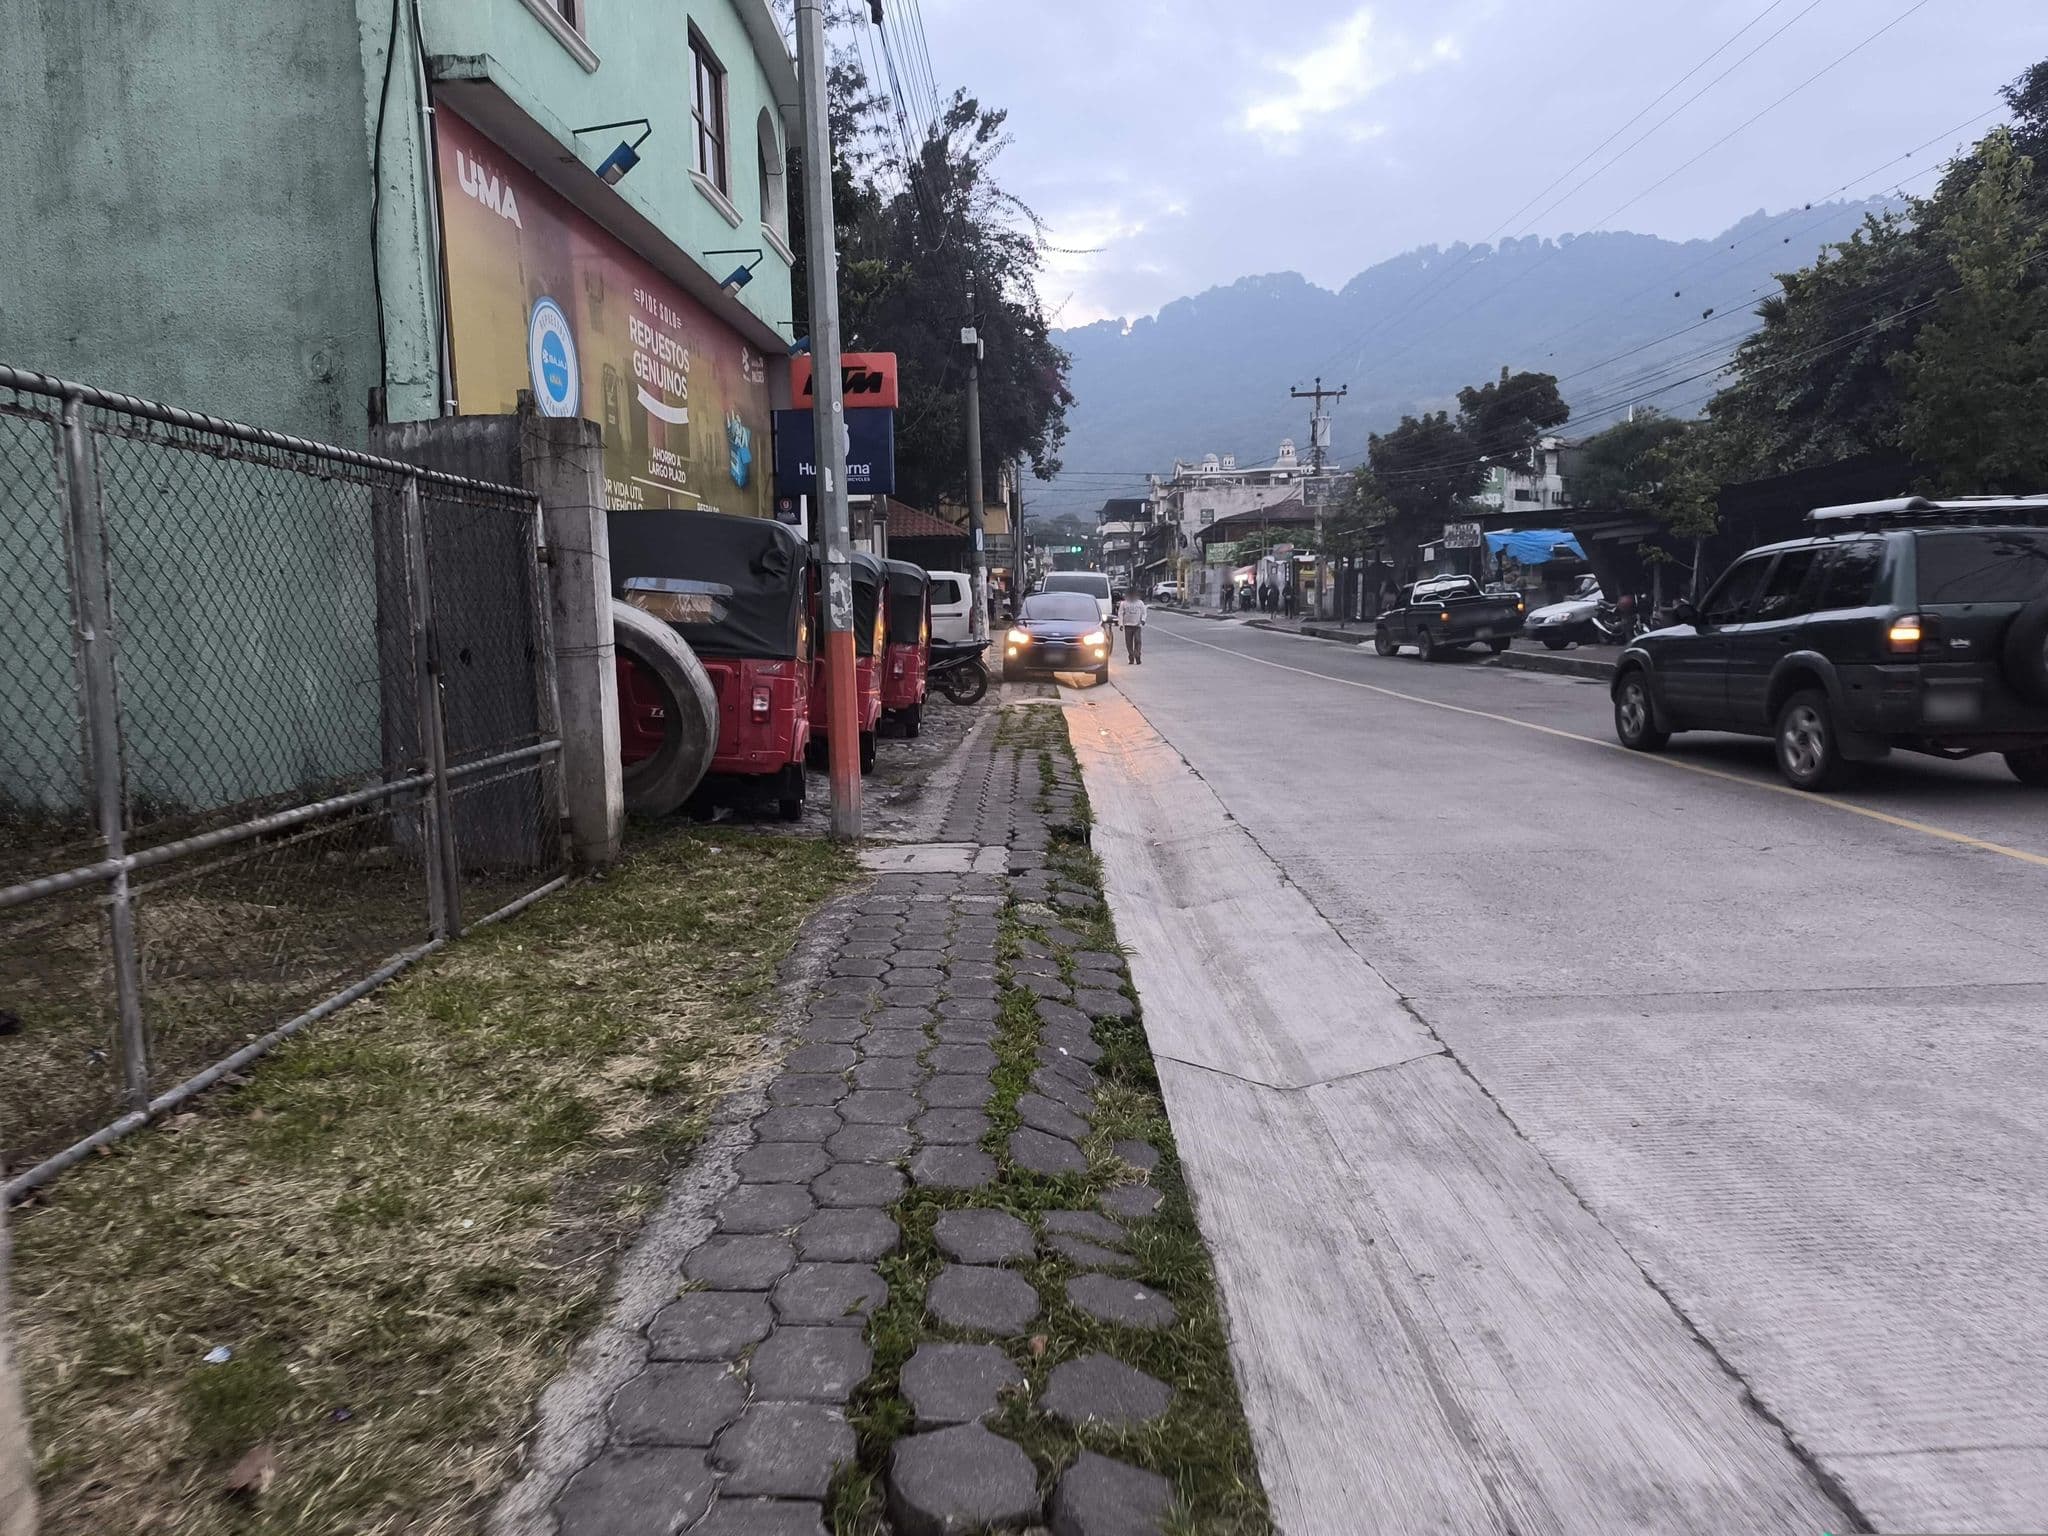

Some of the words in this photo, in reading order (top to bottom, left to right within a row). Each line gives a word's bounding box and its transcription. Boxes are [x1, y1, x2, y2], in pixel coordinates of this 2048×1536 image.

[456, 149, 522, 230] UMA
[640, 289, 658, 317] PIDE
[659, 302, 677, 329] SOLO
[629, 314, 690, 374] REPUESTOS
[633, 349, 688, 401] GENUINOS
[803, 366, 883, 396] TM
[647, 460, 668, 478] LARGO
[668, 466, 687, 484] PLAZO
[652, 446, 677, 466] AHORRO
[676, 455, 682, 469] A
[799, 462, 870, 476] Hurna
[612, 479, 630, 498] VIDA
